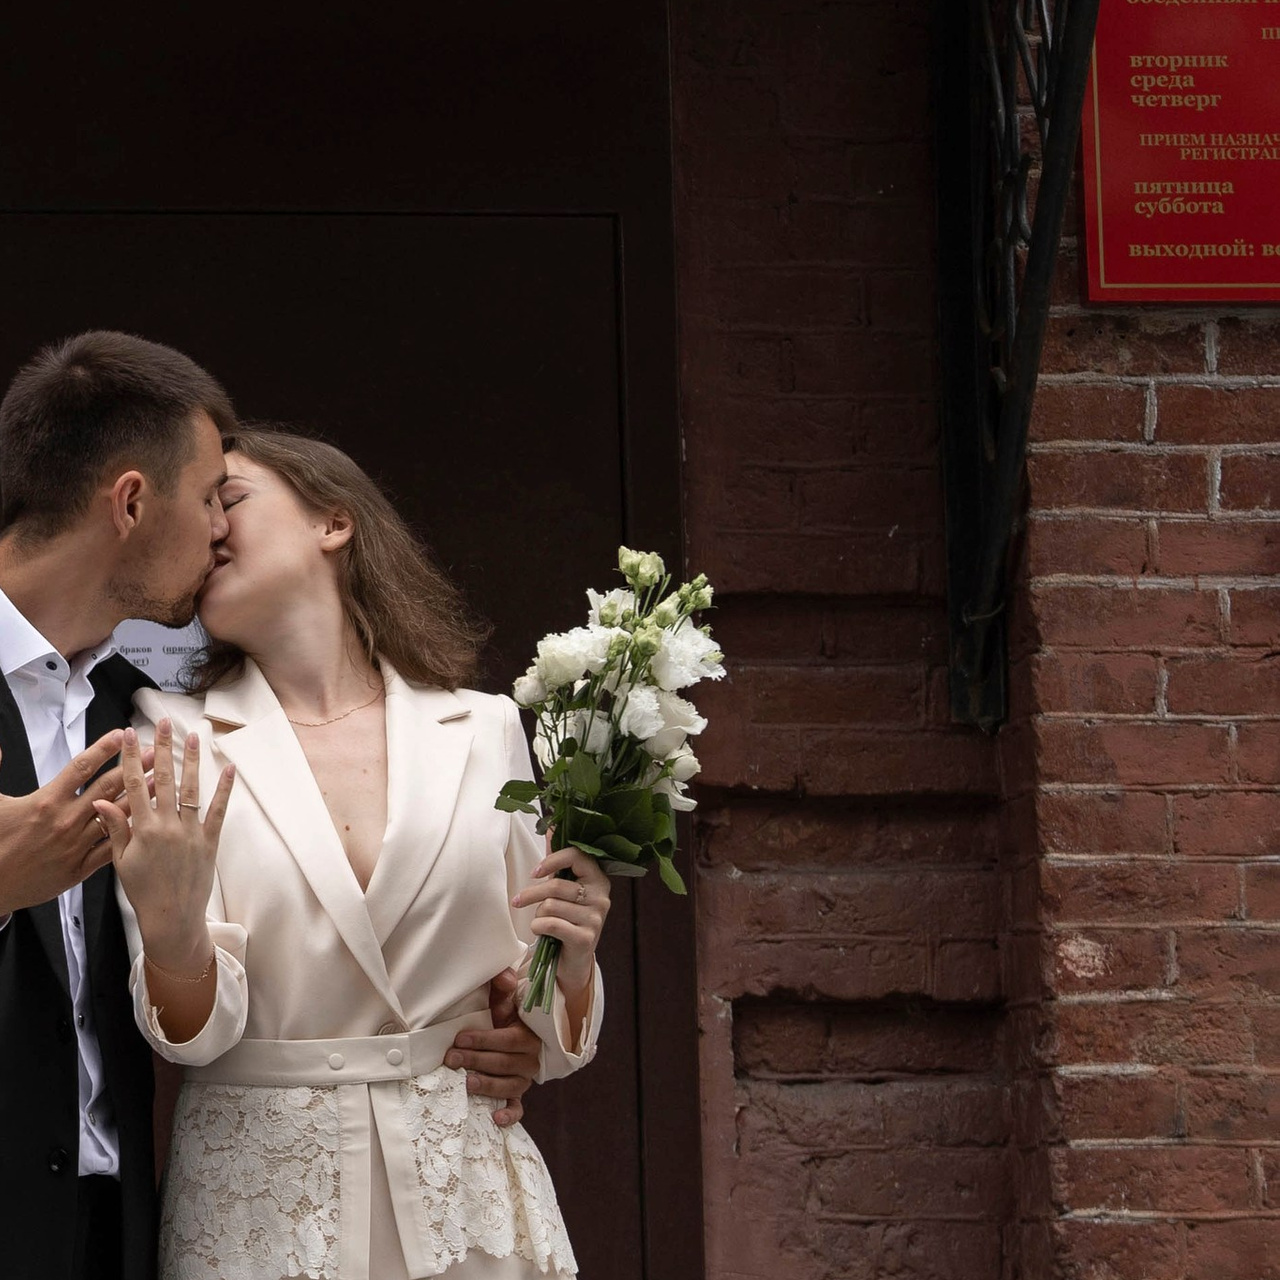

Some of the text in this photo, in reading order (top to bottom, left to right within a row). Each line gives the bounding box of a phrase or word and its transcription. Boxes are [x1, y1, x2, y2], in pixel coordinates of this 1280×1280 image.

[1130, 55, 1229, 71] вторник
[1130, 74, 1195, 91] среда
[1131, 95, 1222, 112] четверг
[1139, 133, 1206, 146] ПРИЕМ
[1134, 181, 1235, 197] пятница
[1134, 197, 1225, 218] суббота
[1128, 238, 1255, 260] выходной:
[120, 645, 152, 656] браков
